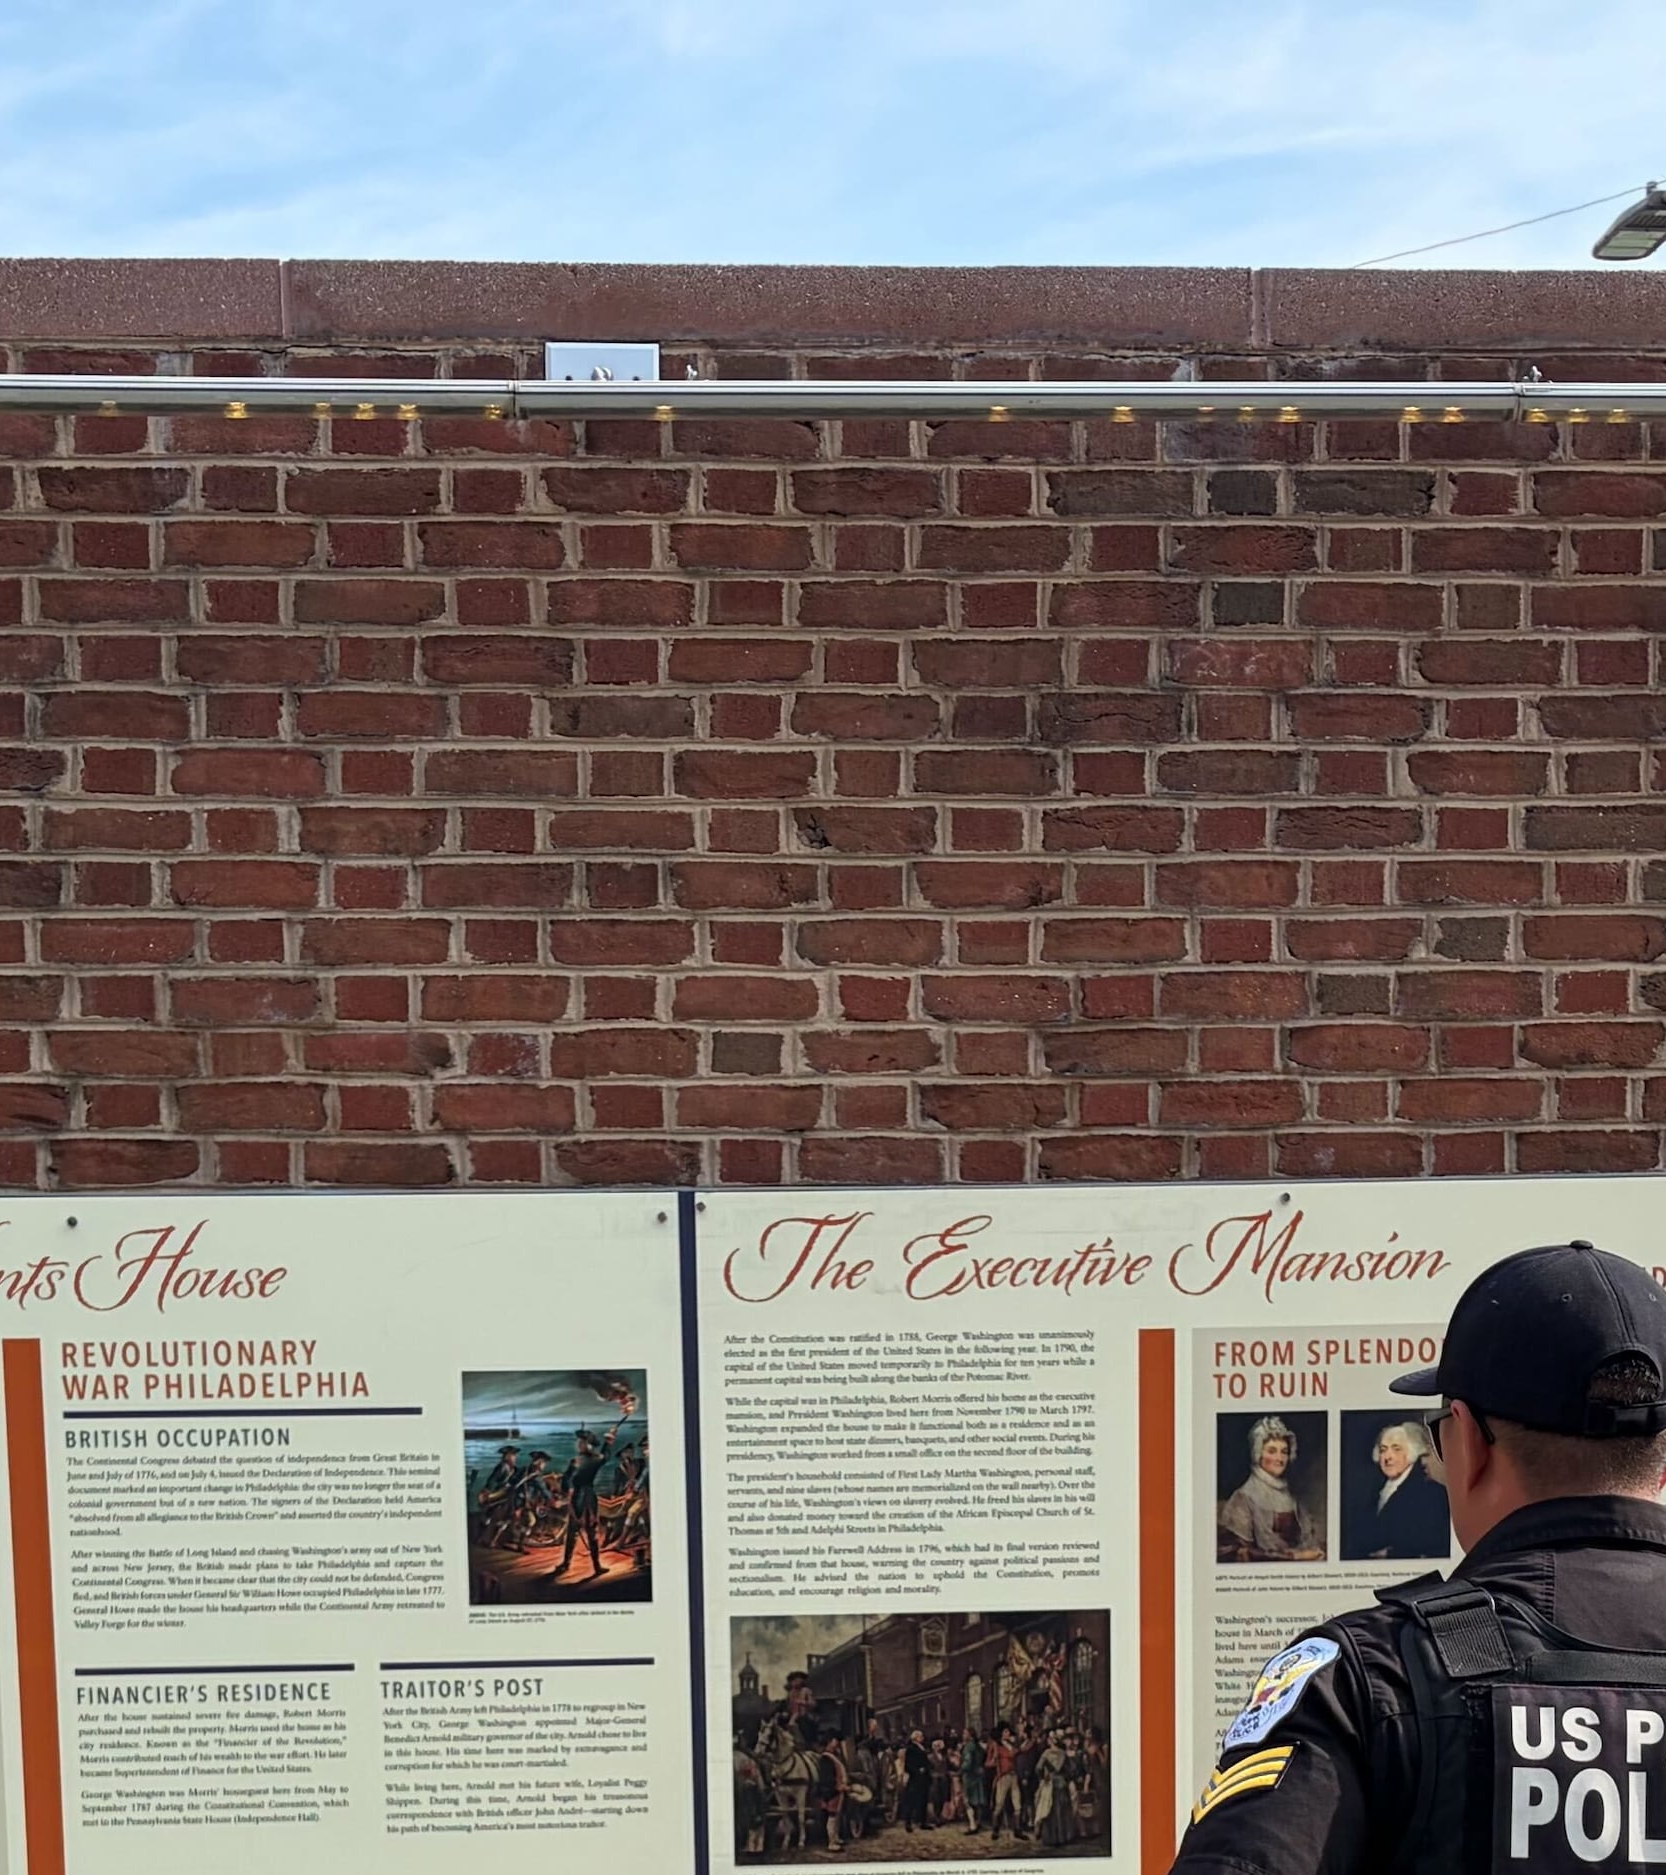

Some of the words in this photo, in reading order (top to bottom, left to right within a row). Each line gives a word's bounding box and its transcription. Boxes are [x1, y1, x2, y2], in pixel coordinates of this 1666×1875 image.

[74, 1219, 287, 1313] House
[724, 1211, 875, 1302] The
[903, 1214, 1153, 1299] Executive
[1169, 1209, 1452, 1303] Mansion
[62, 1341, 314, 1367] REVOLUTIONARY
[1214, 1341, 1294, 1367] FROM
[1307, 1336, 1444, 1366] SPLENDO
[64, 1375, 128, 1399] WAR
[145, 1373, 368, 1399] PHILADELPHIA
[1213, 1373, 1247, 1399] TO
[1259, 1371, 1328, 1398] RUIN
[65, 1430, 147, 1448] BRITISH
[157, 1428, 289, 1447] OCCUPATION
[1255, 1628, 1283, 1636] March
[1285, 1627, 1294, 1635] of
[77, 1685, 207, 1705] FINANCIER'S
[218, 1683, 330, 1702] RESIDENCE
[381, 1679, 484, 1699] TRAITOR'S
[494, 1678, 543, 1696] POST
[1511, 1705, 1602, 1763] US
